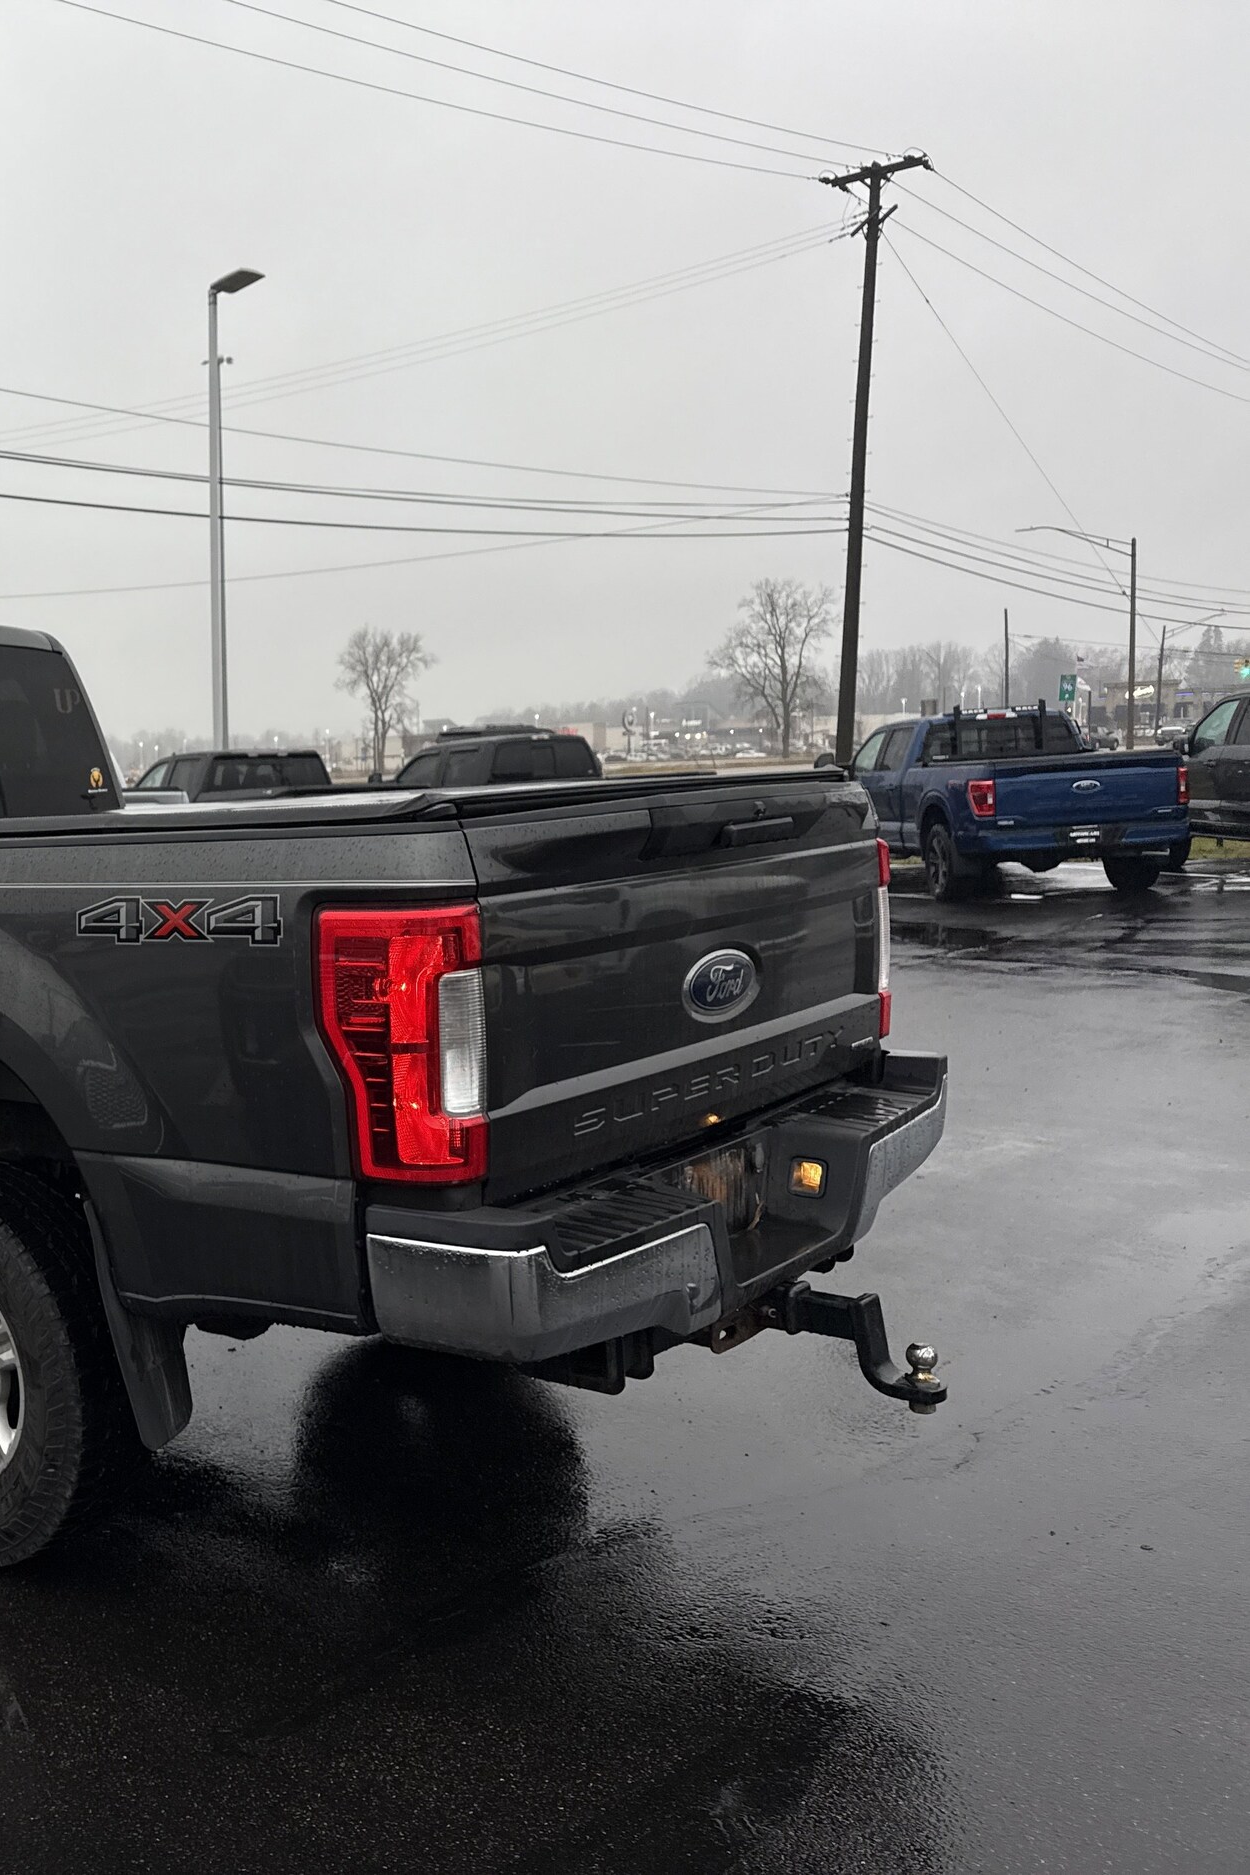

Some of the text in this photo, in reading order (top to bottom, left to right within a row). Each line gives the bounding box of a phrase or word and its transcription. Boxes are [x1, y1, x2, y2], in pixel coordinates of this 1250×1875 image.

[706, 962, 744, 1003] Ford
[573, 1025, 845, 1137] SUPER DUTY
